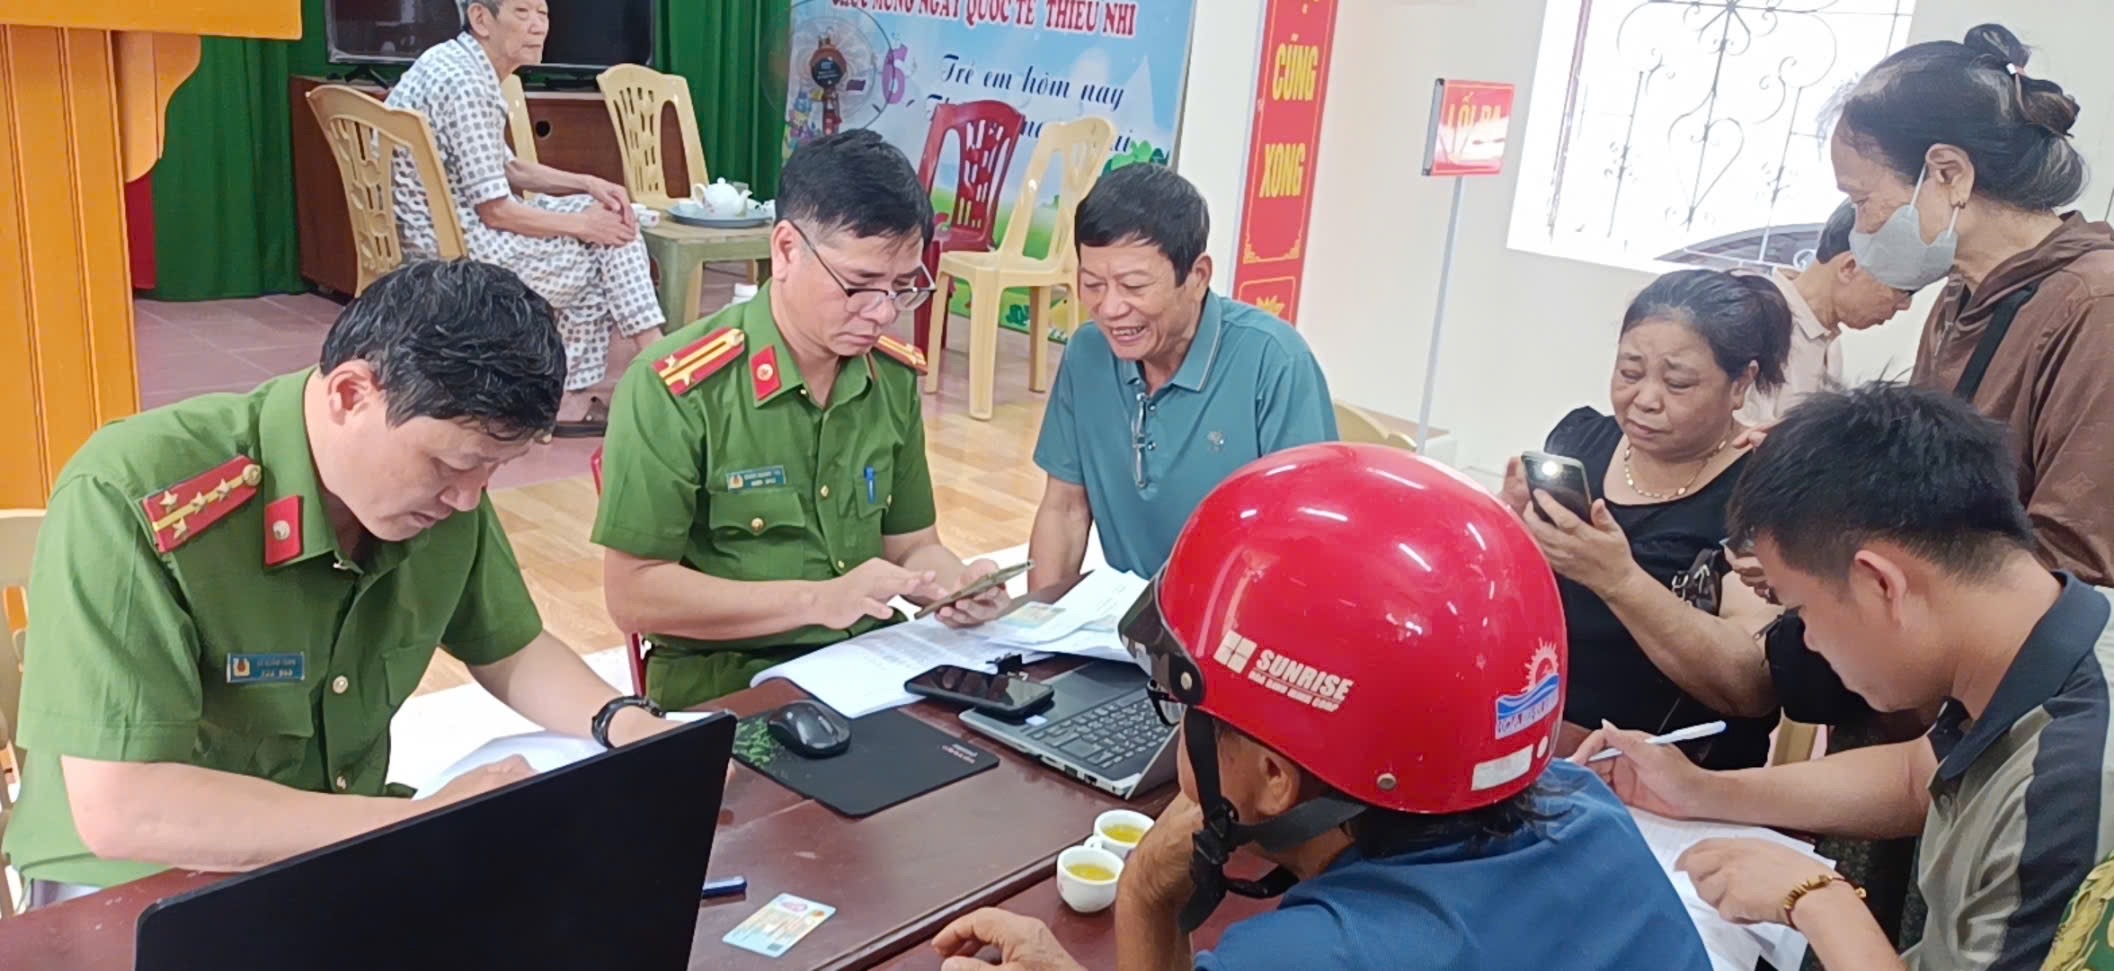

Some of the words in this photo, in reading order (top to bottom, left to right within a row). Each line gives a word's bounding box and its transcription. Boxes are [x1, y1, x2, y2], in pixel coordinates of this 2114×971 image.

[1102, 2, 1137, 36] NHI
[983, 70, 1013, 90] em
[1080, 83, 1125, 112] nay
[1258, 142, 1307, 198] XONG
[1255, 649, 1355, 702] SUNRISE
